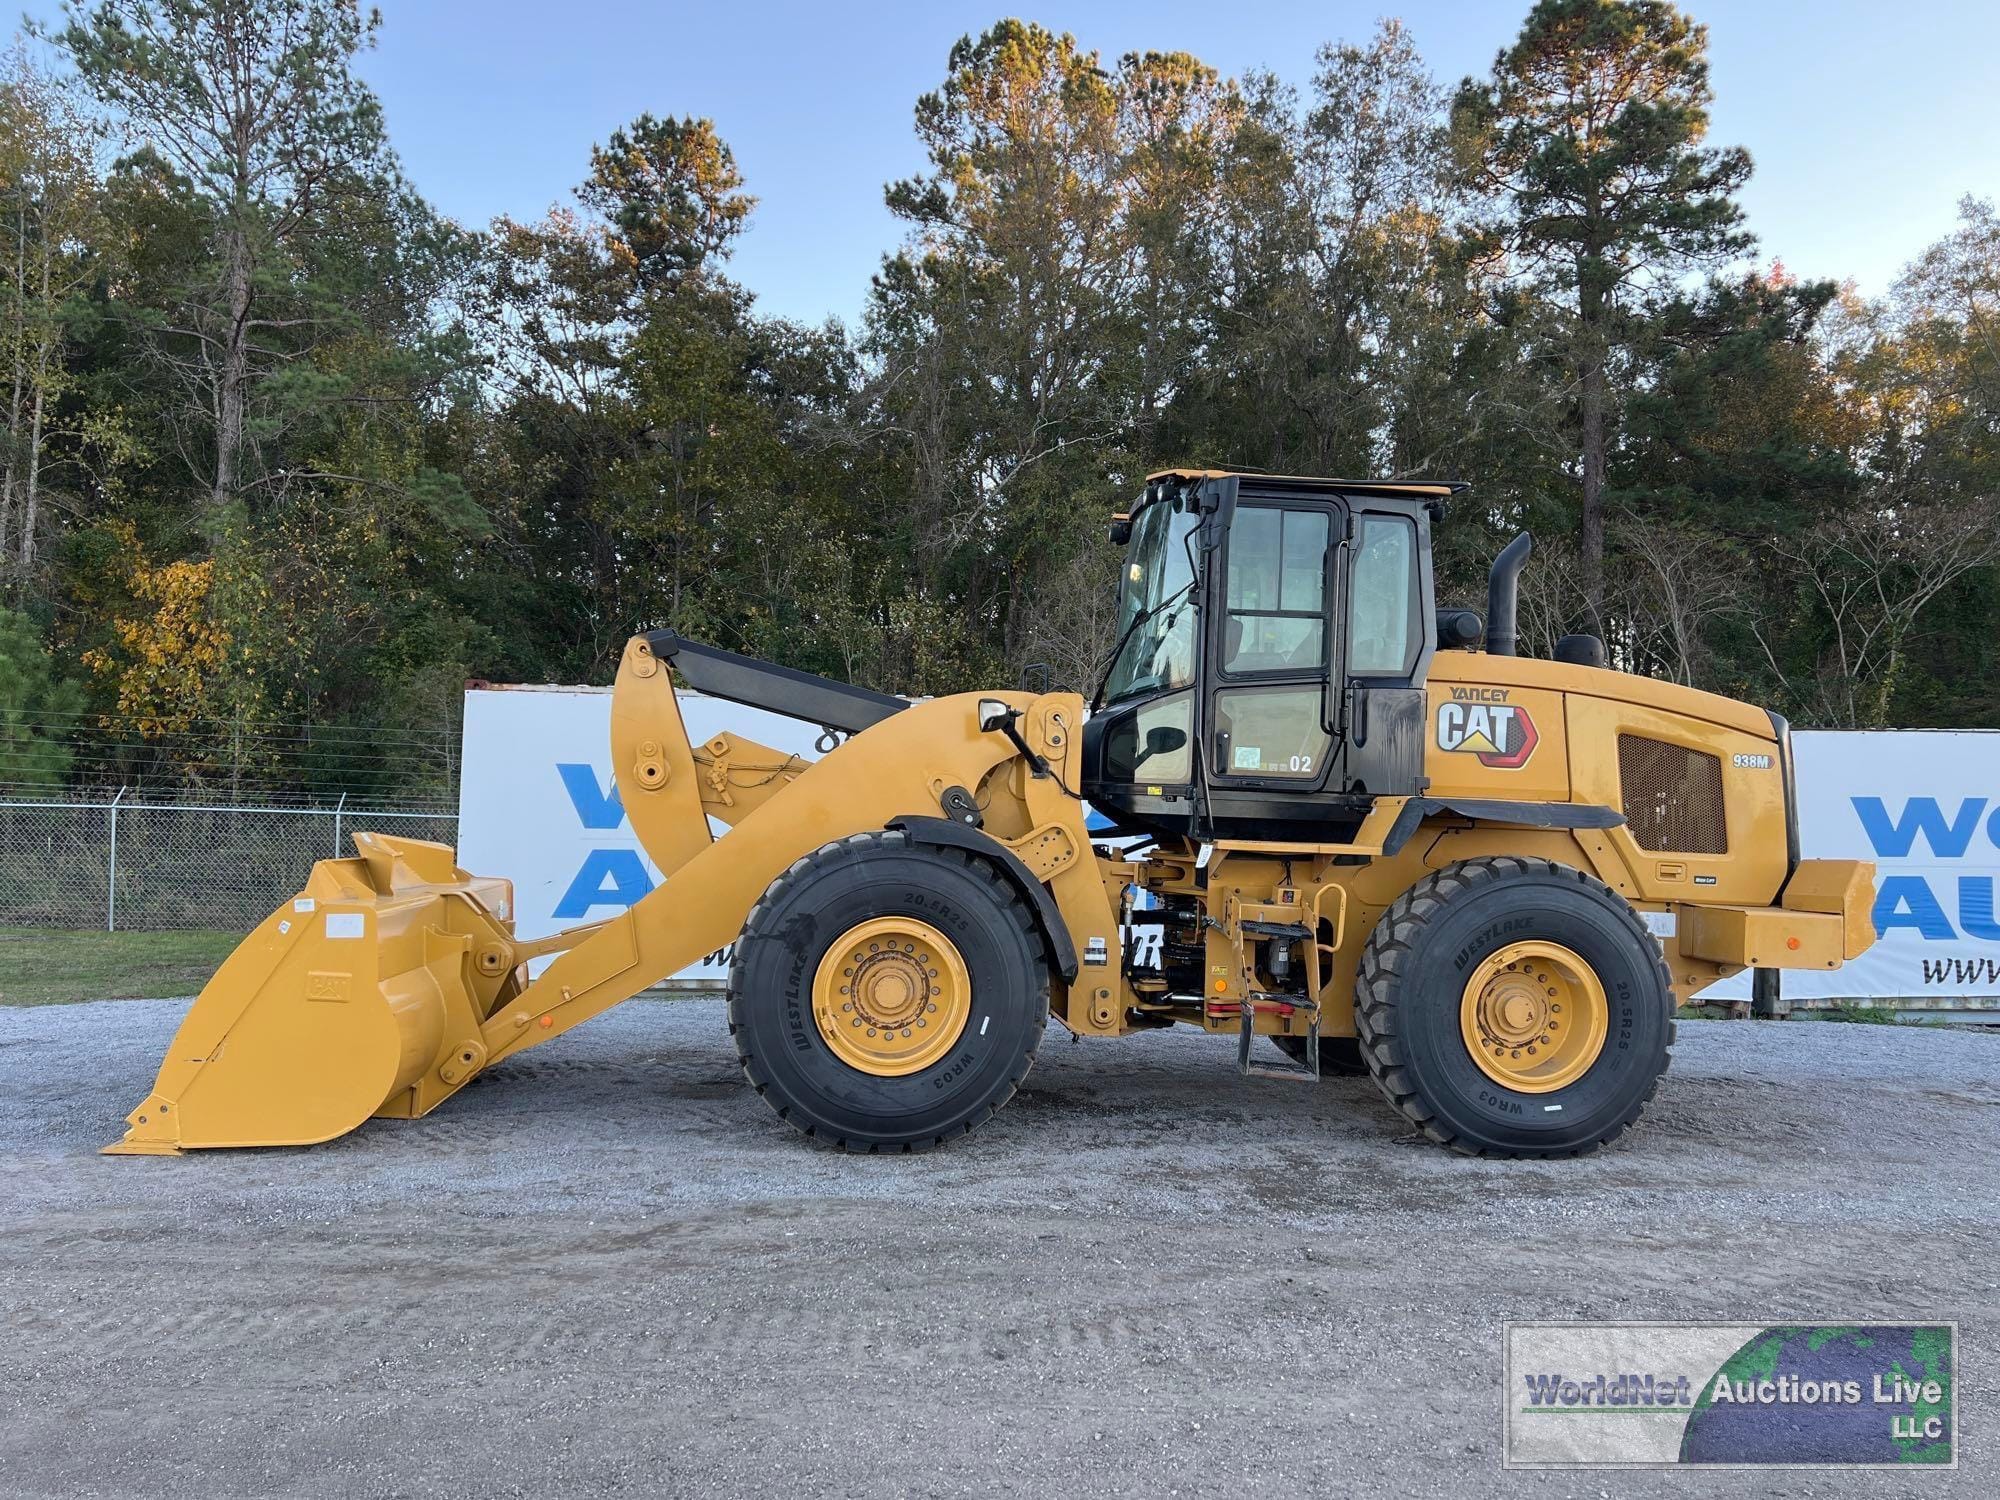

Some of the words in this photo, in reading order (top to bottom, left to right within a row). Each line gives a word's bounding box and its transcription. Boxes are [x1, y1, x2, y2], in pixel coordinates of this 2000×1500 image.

[1449, 686, 1510, 702] YANCEY
[1438, 703, 1514, 753] CAT
[1289, 755, 1311, 772] 02
[1733, 754, 1769, 769] 938M
[903, 892, 969, 931] 20.5R25
[1454, 917, 1535, 973] WESTLAKE
[785, 951, 812, 1051] WESTLAKE
[1617, 981, 1633, 1051] 20.5R25
[933, 1053, 975, 1090] WR03
[1479, 1090, 1522, 1115] WR03
